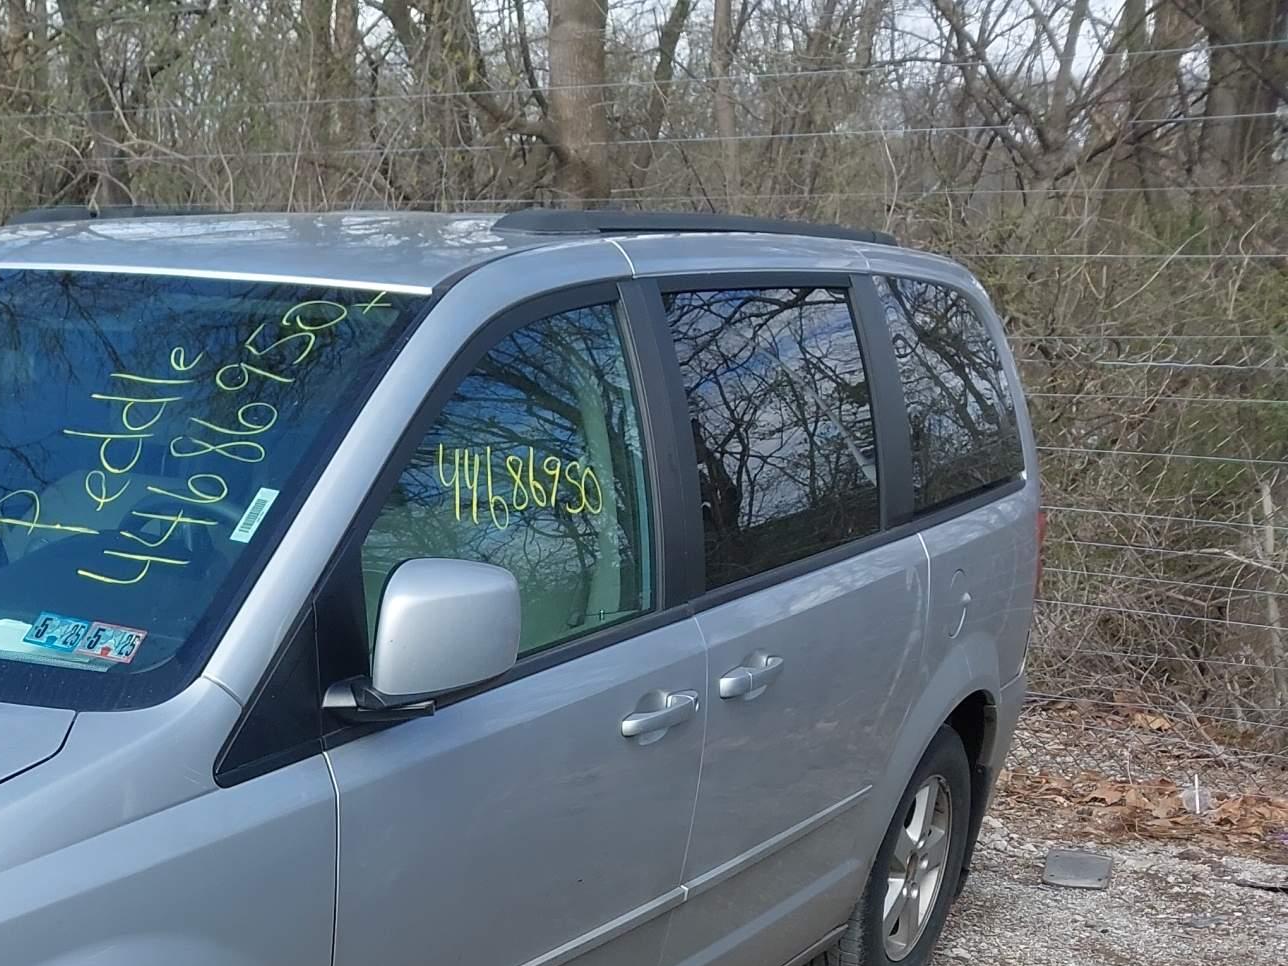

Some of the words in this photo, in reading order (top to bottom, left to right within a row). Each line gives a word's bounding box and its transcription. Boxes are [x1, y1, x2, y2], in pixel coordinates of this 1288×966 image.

[77, 300, 348, 584] 44686950
[439, 443, 603, 530] 44686950
[63, 623, 86, 647] 25
[118, 633, 141, 657] 25
